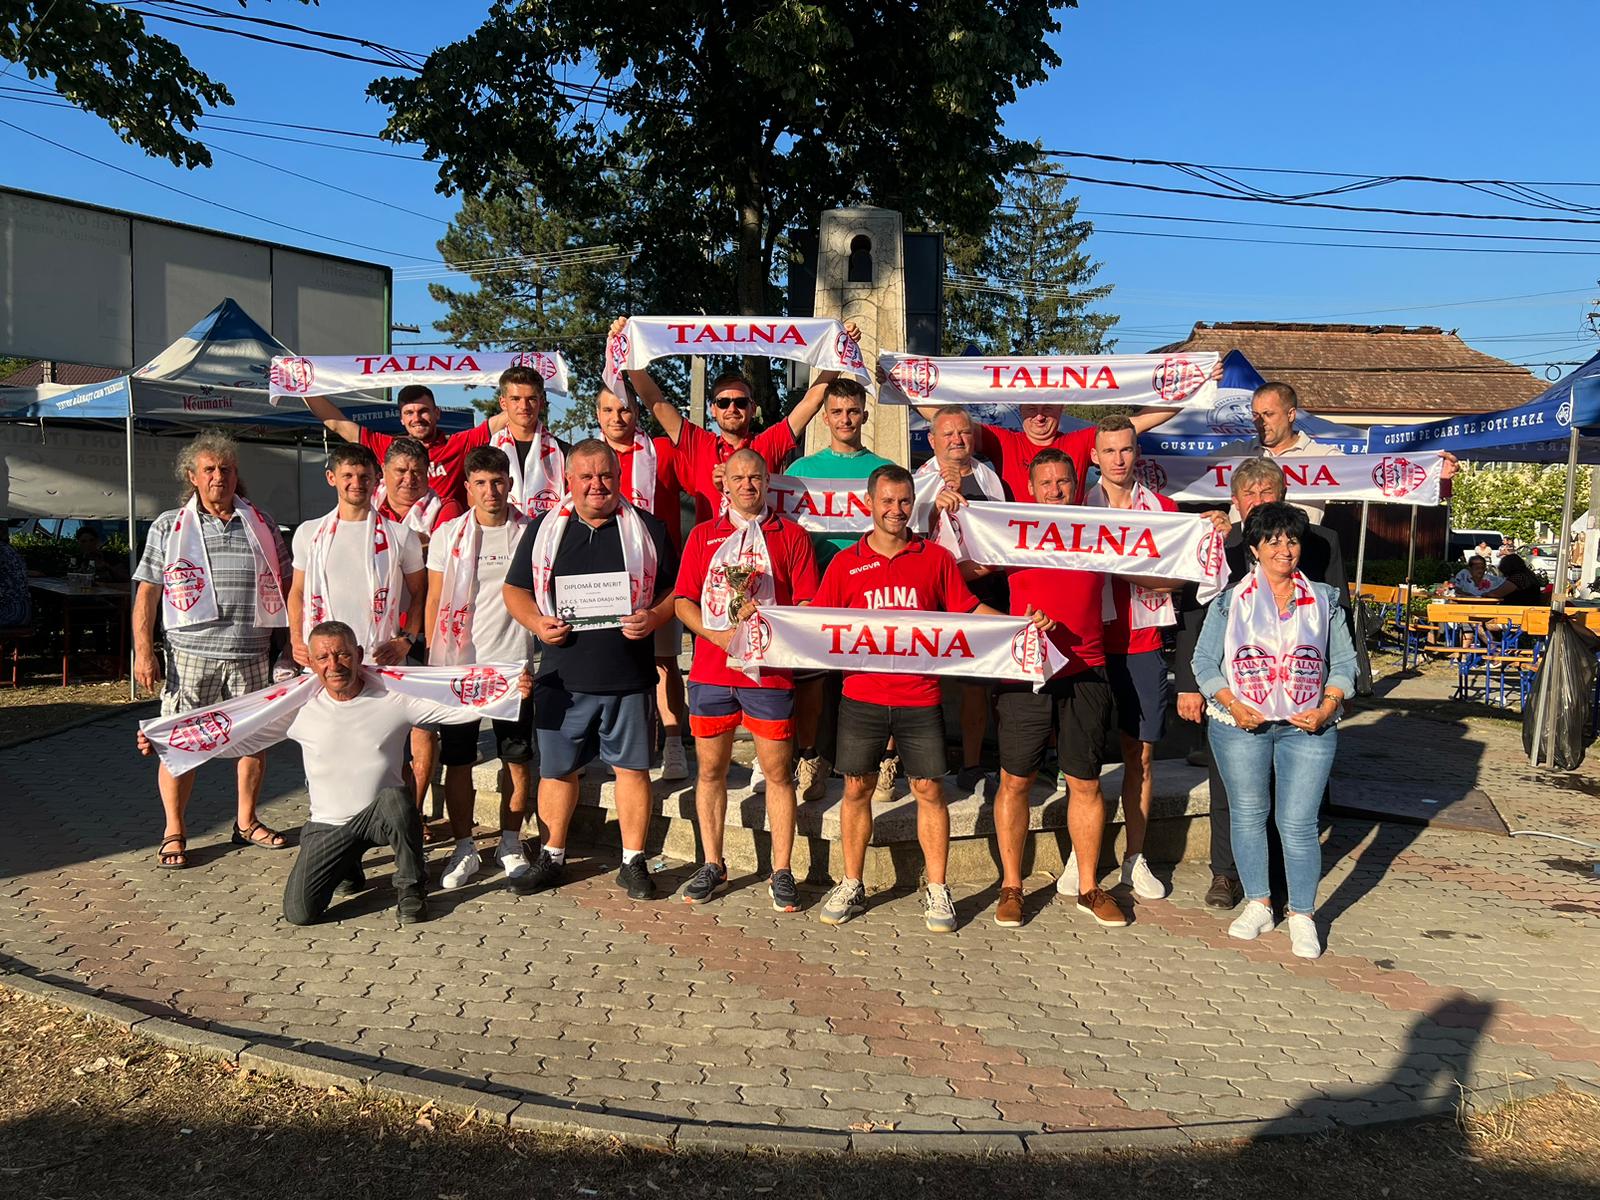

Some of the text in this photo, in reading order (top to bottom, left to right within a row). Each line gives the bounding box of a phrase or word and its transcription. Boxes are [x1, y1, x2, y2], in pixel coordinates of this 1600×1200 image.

[667, 324, 807, 346] TALNA
[355, 355, 481, 375] TALNA
[918, 362, 927, 392] TALNA
[983, 365, 1120, 390] TALNA
[1164, 363, 1175, 395] TALNA
[183, 394, 232, 410] Neumarkt
[352, 411, 383, 421] PENTRU
[1384, 431, 1417, 445] GUSTUL
[1433, 424, 1460, 439] CARE
[1463, 422, 1476, 435] TE
[1480, 417, 1508, 433] POȚI
[1512, 412, 1544, 427] BAZA
[1161, 441, 1214, 450] GUSTUL
[1206, 464, 1340, 486] TNA
[1386, 463, 1395, 489] TALNA
[767, 489, 871, 517] TALN
[1008, 520, 1161, 558] TALNA
[164, 571, 196, 582] TALNA
[849, 561, 881, 575] GIVOVA
[564, 582, 592, 590] DIPLOMĂ
[864, 586, 918, 610] TALNA
[749, 617, 761, 651] TALNA
[821, 624, 975, 658] TALNA
[1026, 629, 1037, 667] TALNA
[1235, 660, 1269, 671] TALNA
[1289, 660, 1320, 671] TALNA
